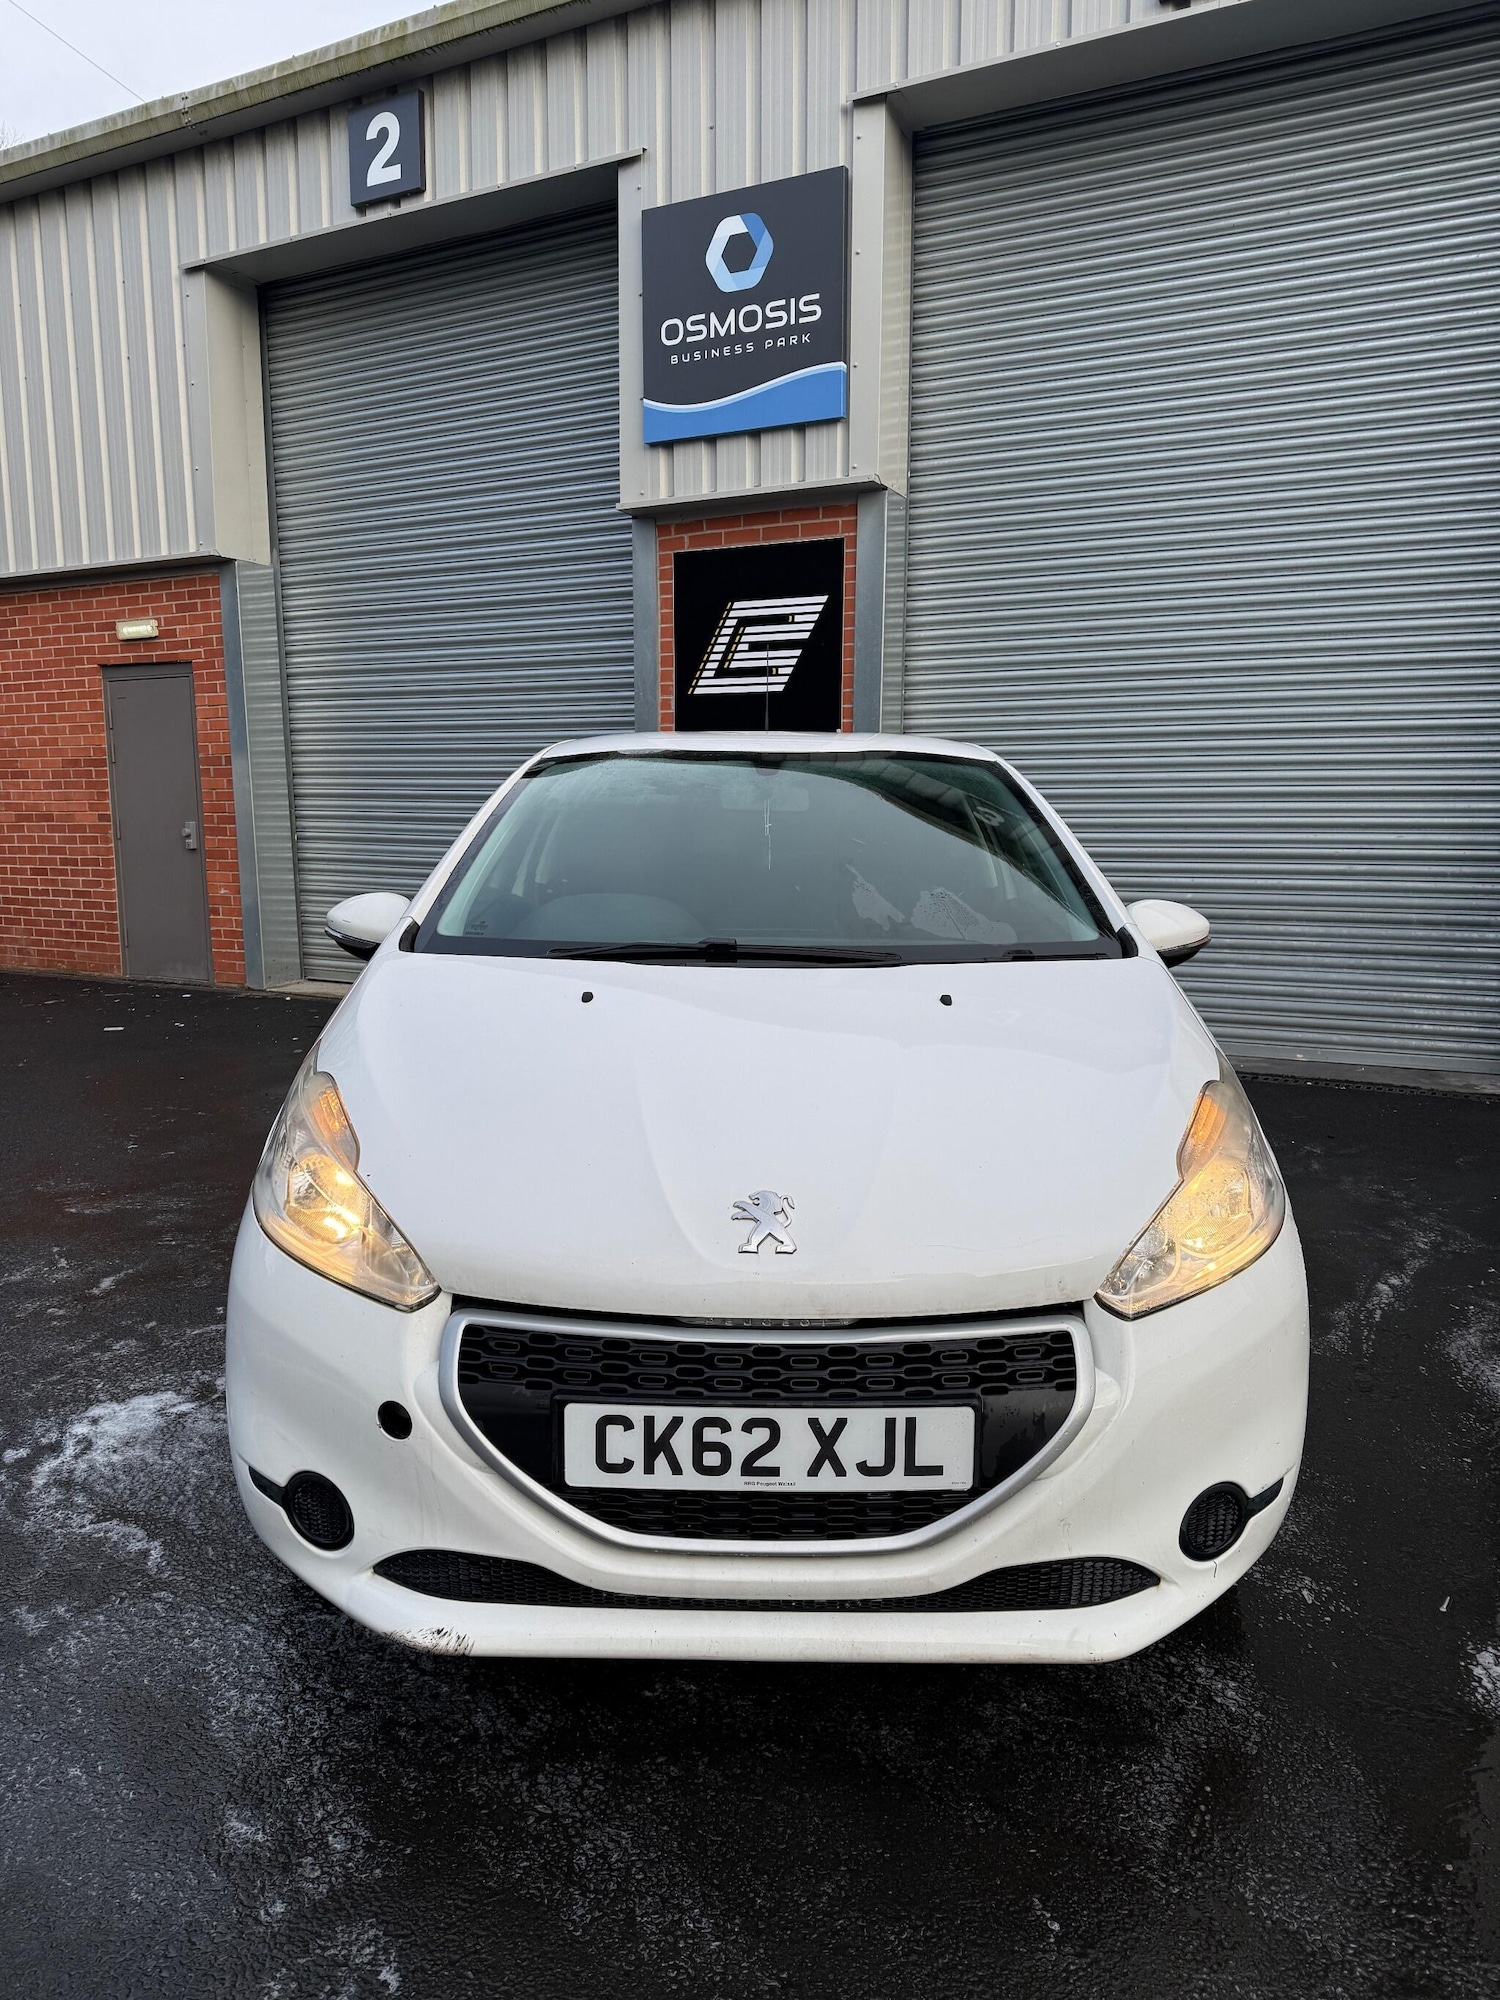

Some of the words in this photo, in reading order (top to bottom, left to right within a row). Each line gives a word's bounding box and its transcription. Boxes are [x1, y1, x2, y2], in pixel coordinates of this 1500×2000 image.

[366, 111, 402, 187] 2
[660, 293, 822, 346] OSMOSIS
[670, 342, 754, 365] BUSINESS
[765, 332, 811, 349] PARK
[595, 1414, 781, 1478] CK62
[806, 1416, 944, 1478] XJL
